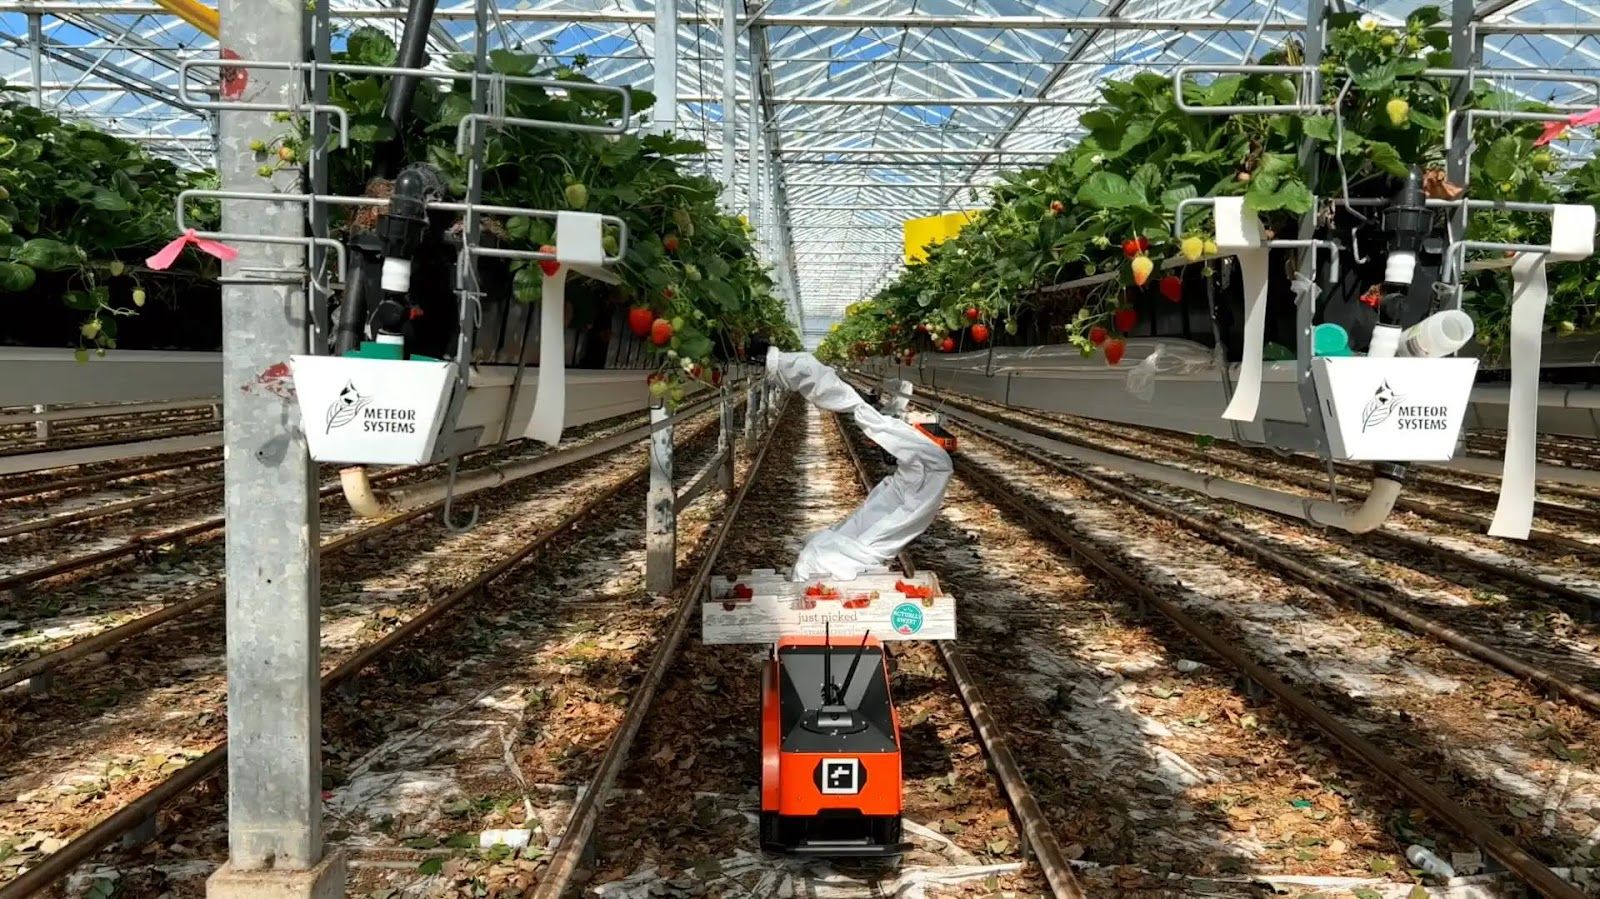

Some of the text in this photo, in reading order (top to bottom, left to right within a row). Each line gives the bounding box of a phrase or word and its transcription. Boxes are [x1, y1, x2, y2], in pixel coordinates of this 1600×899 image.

[364, 408, 416, 420] METEOR
[1398, 406, 1447, 417] METEOR
[363, 420, 416, 433] SYSTEMS
[1398, 418, 1447, 430] SYSTEMS
[798, 610, 858, 624] just picked
